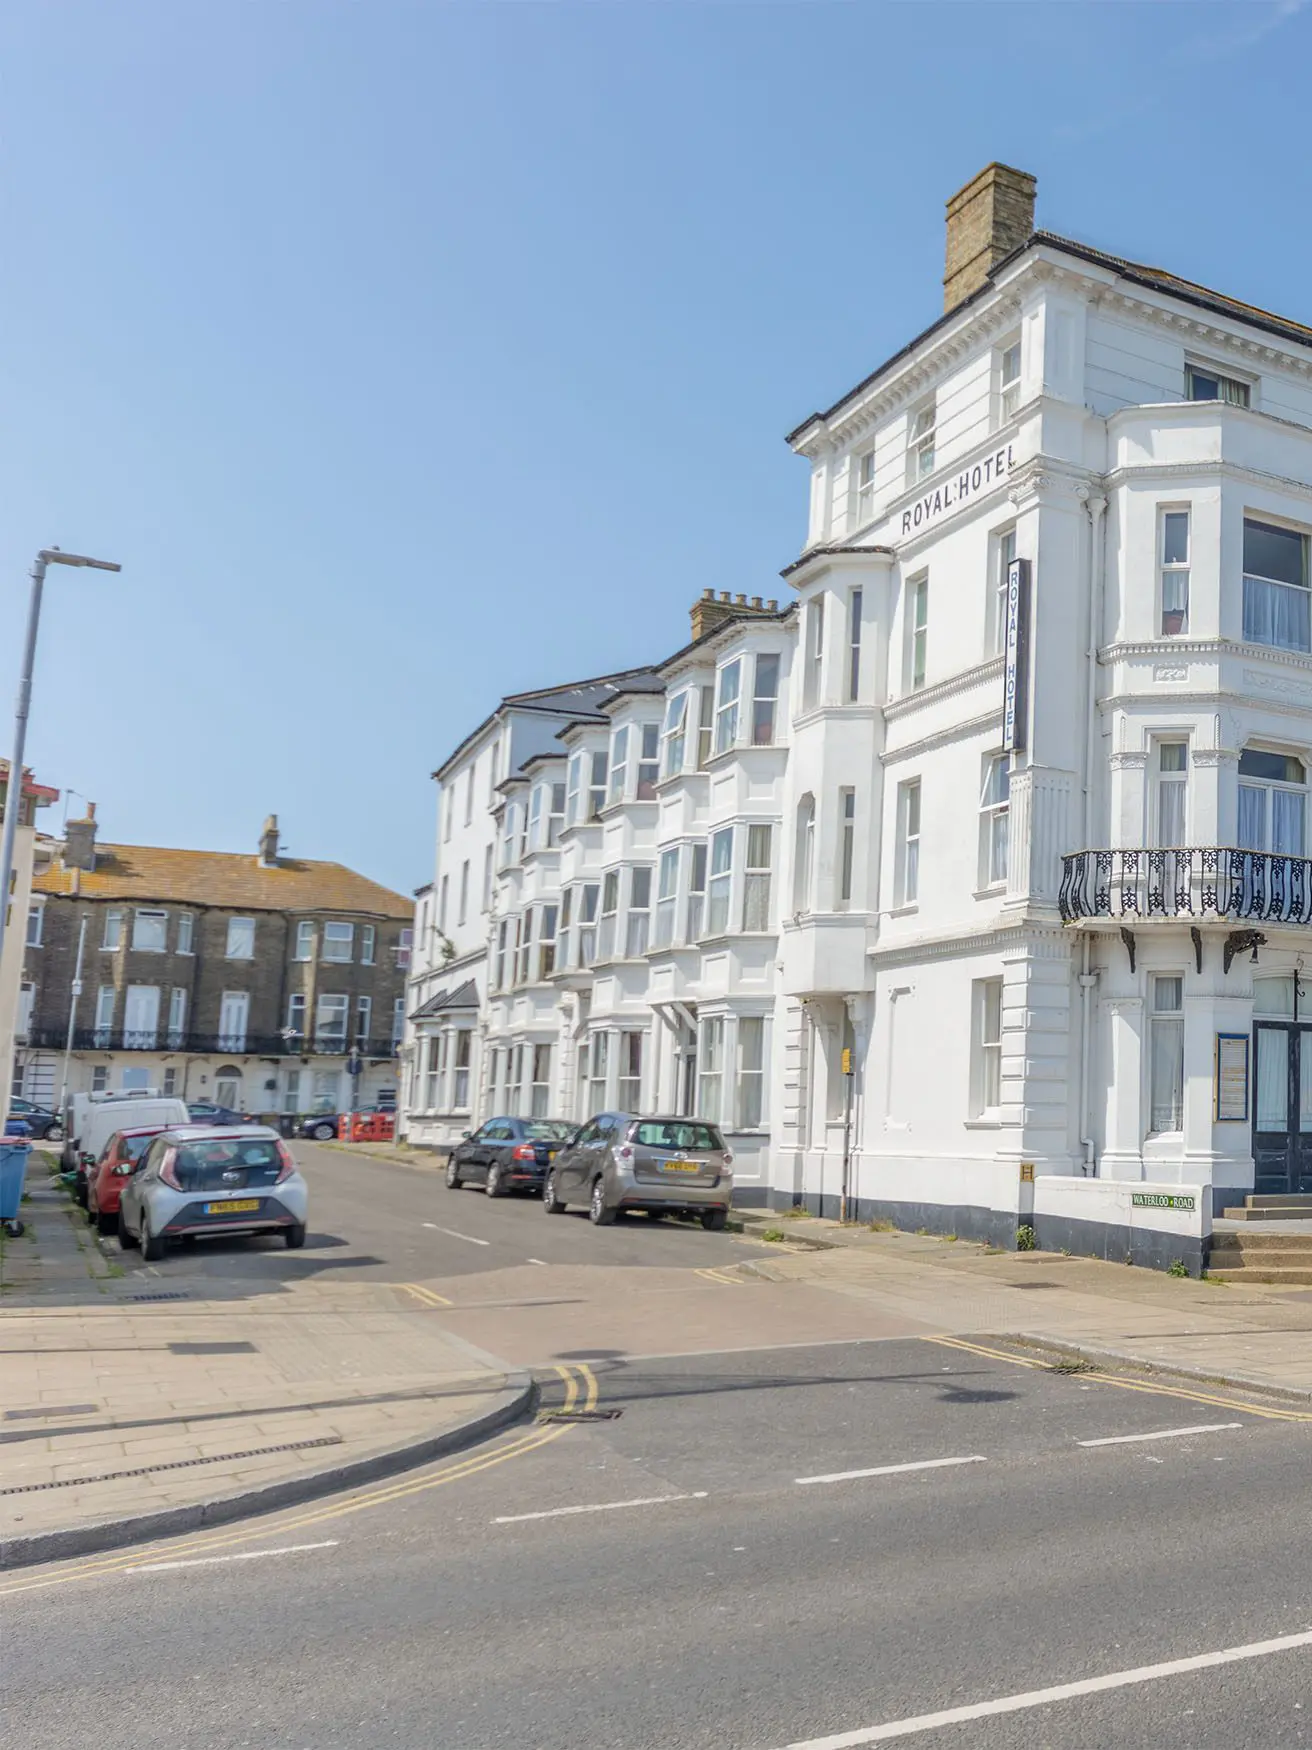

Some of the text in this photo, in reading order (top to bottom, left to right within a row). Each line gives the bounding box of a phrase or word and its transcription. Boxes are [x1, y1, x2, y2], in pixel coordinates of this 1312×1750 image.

[1006, 571, 1018, 741] ROYAL HOTEL
[1133, 1194, 1194, 1208] WATERLOO ROAD
